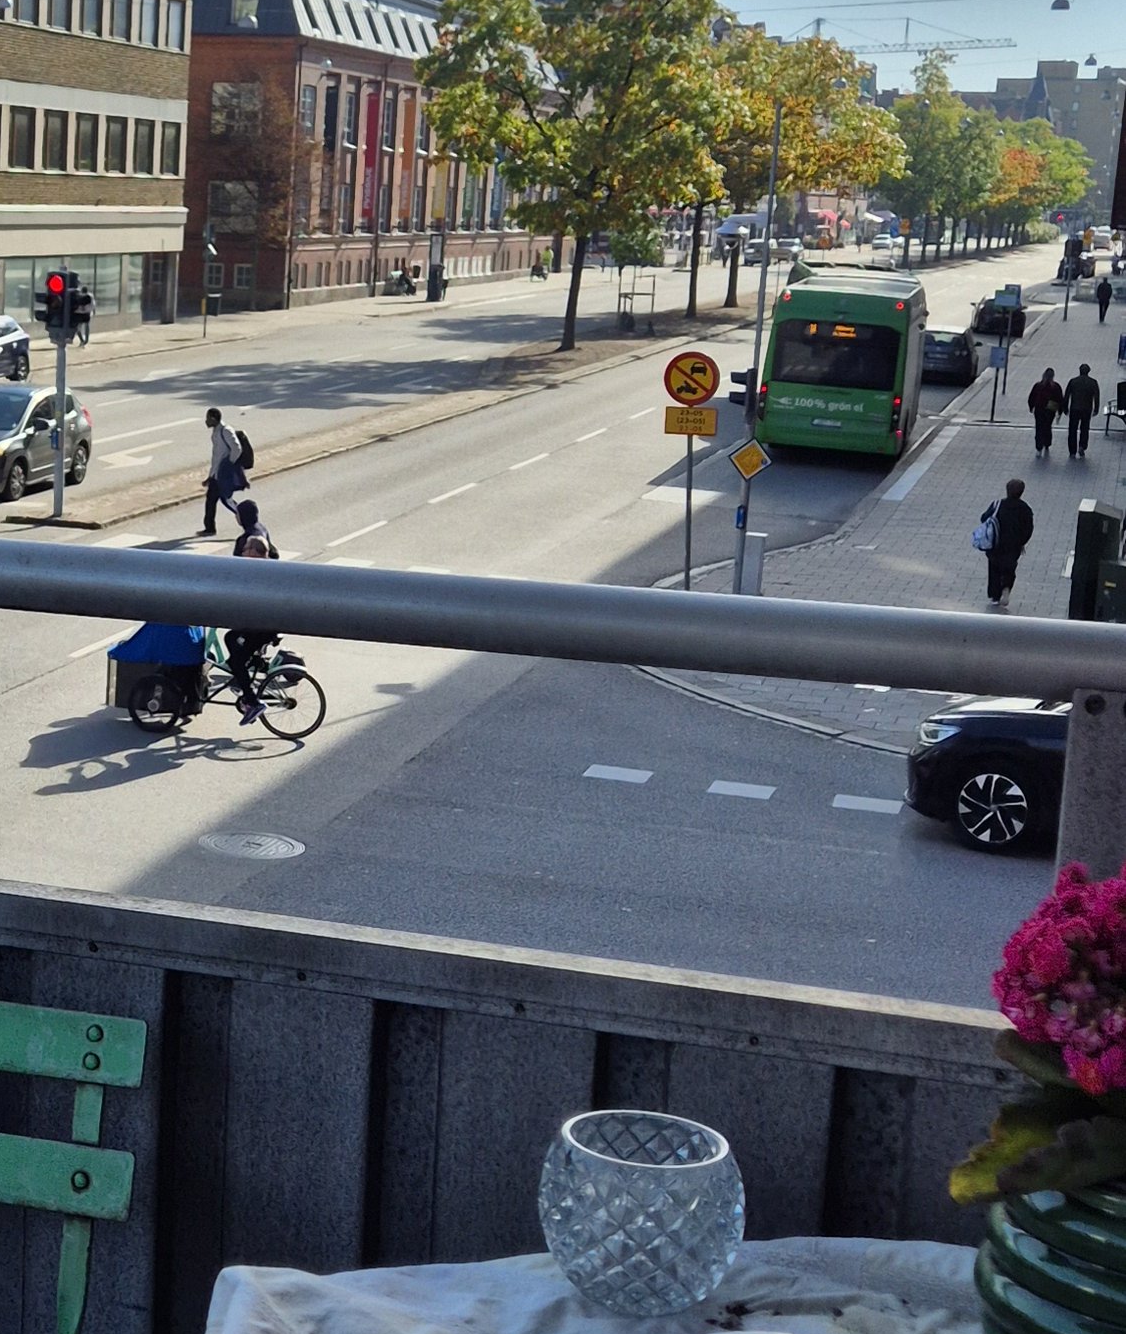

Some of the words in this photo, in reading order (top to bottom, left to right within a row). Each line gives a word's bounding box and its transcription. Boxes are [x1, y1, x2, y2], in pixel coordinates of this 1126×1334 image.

[827, 401, 852, 413] grön
[679, 409, 704, 417] 23-05
[676, 416, 706, 425] (23-05)
